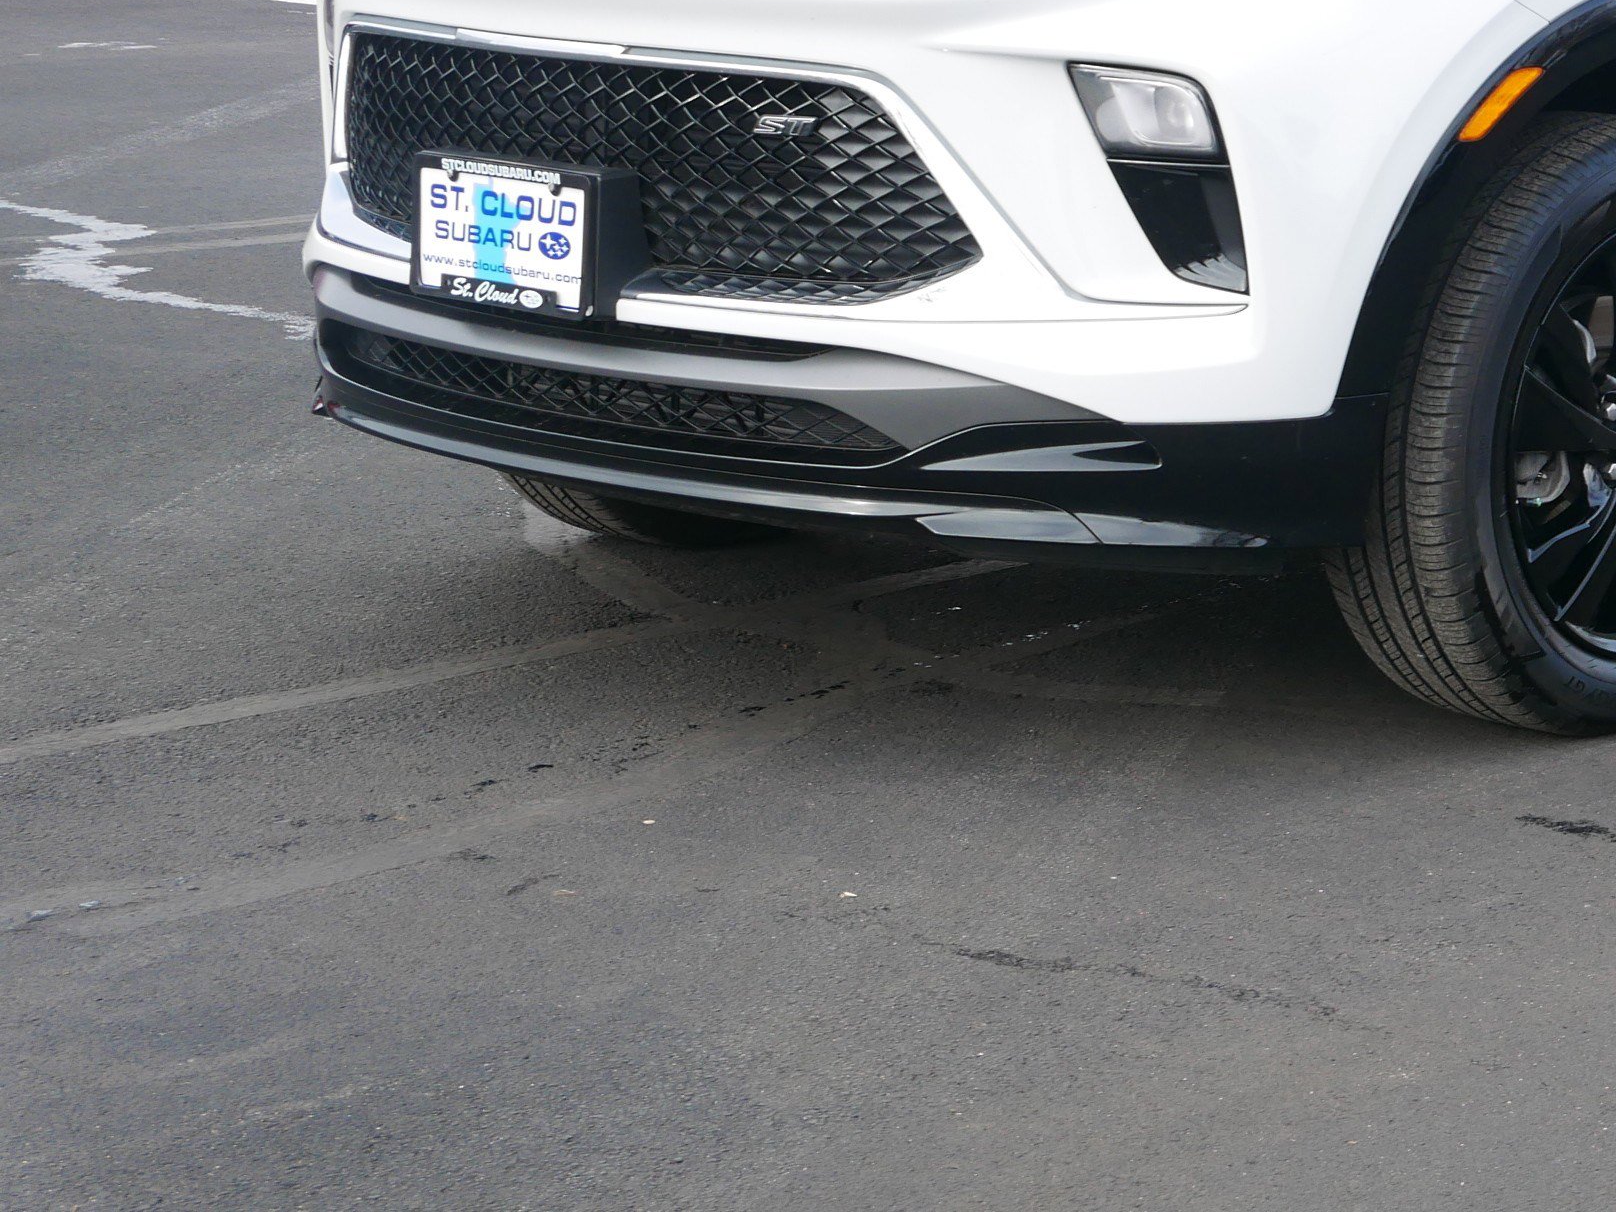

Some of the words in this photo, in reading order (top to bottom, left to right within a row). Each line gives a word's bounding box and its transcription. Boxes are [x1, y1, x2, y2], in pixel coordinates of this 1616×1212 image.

[754, 114, 817, 137] ST
[440, 157, 562, 186] STCLOUDSUBARU.COM
[429, 183, 470, 213] ST.
[480, 190, 578, 228] CLOUD
[434, 219, 533, 253] SUBARU
[422, 252, 582, 285] www.stcloudsubaru.com
[450, 277, 473, 299] St.
[474, 281, 519, 306] Cloud
